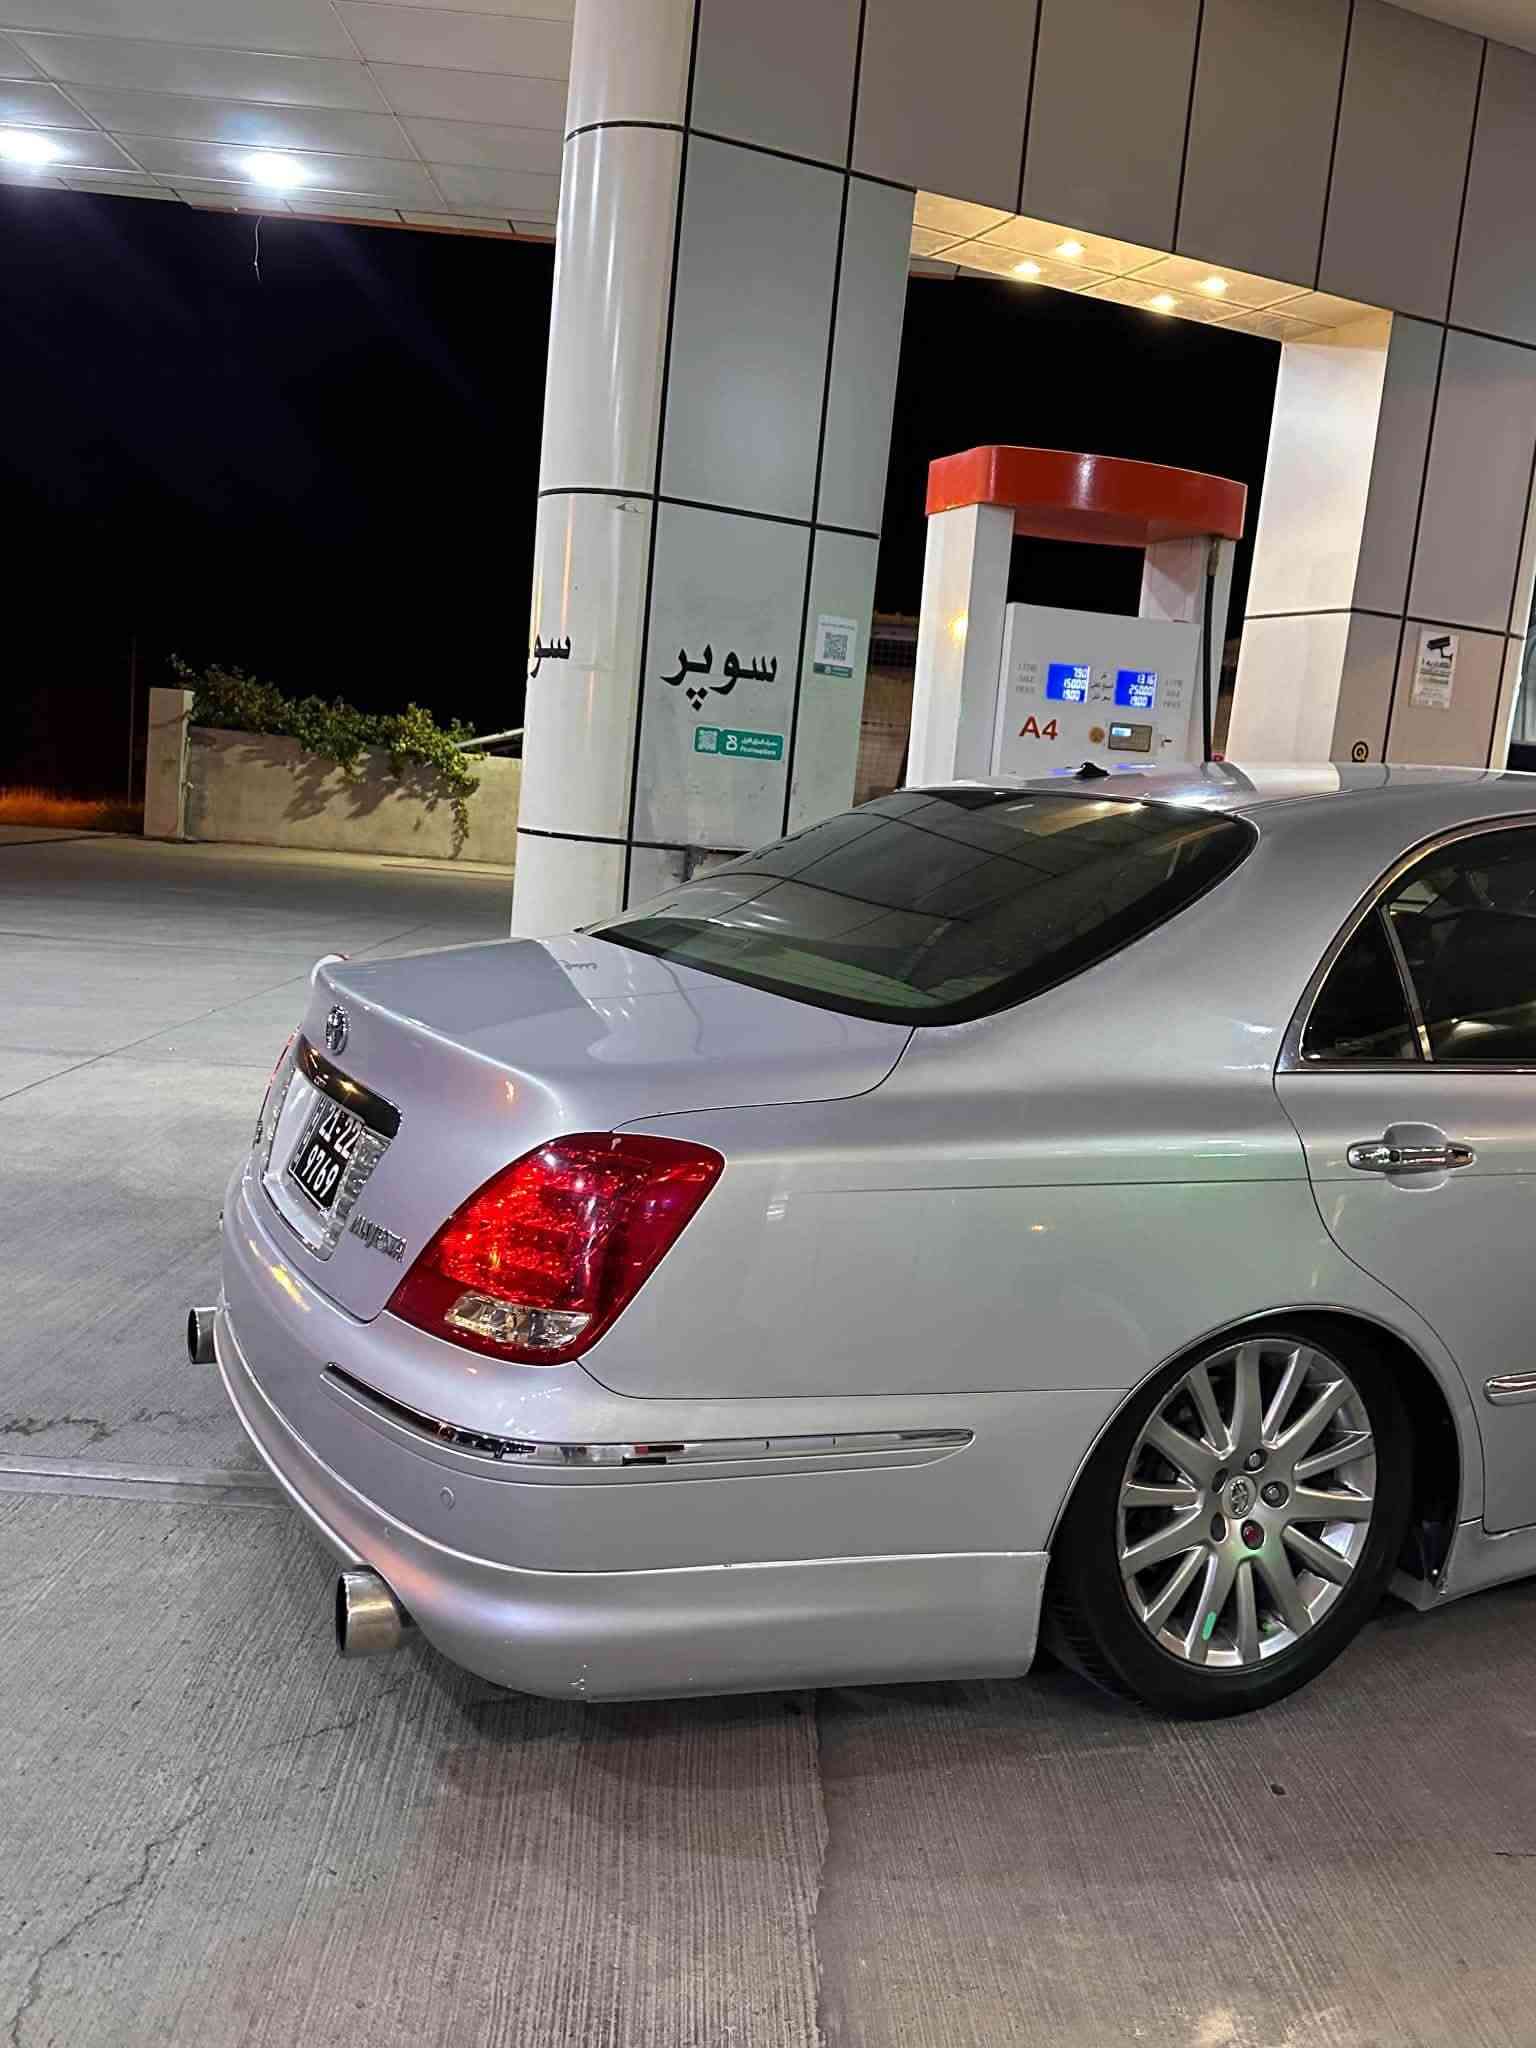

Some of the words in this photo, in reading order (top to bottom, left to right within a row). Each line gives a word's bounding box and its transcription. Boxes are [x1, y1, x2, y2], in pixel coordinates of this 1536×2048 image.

[659, 643, 778, 711] سوپر
[1019, 715, 1058, 740] A4
[301, 1145, 340, 1198] 9769
